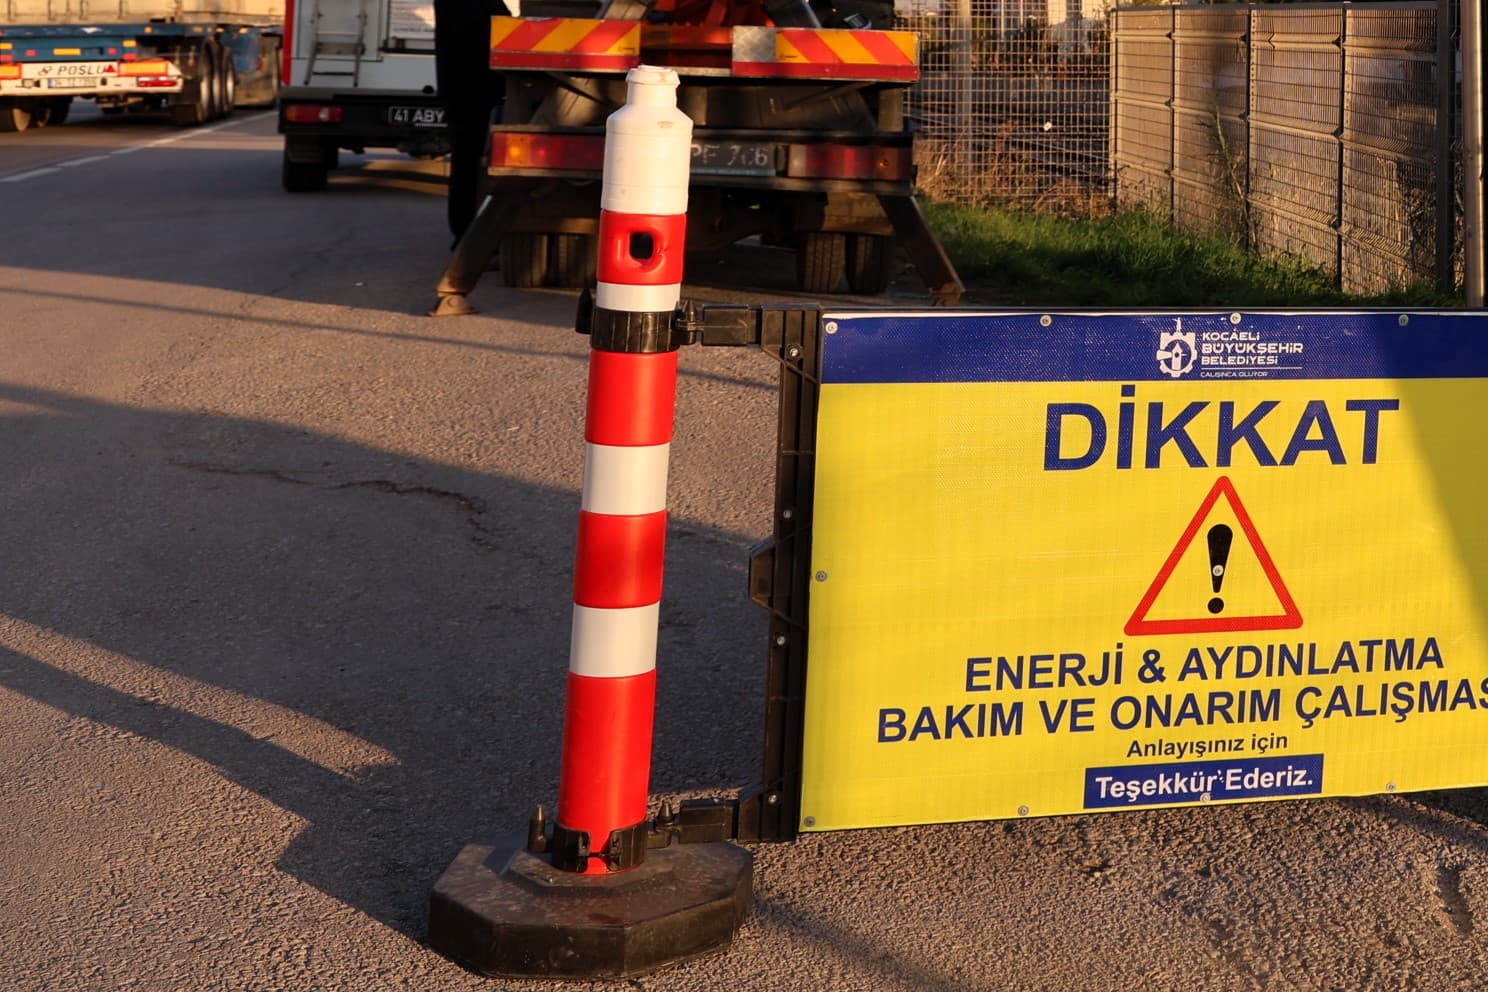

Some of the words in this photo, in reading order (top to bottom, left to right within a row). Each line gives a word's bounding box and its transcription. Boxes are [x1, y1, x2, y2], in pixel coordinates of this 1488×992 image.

[394, 109, 409, 121] 41
[1201, 342, 1304, 355] BÜYÜKŞEHİR
[1202, 331, 1260, 341] KOCAELİ
[1201, 355, 1278, 366] BELEDİYESİ
[1043, 384, 1400, 471] DİKKAT
[965, 643, 1124, 692] ENERJİ
[1137, 651, 1166, 685] &
[1179, 636, 1445, 682] AYDINLATMA
[876, 700, 1024, 743] BAKIM
[1038, 697, 1096, 734] VE
[1110, 688, 1282, 730] ONARIM
[1126, 738, 1244, 759] Anlayışınız
[1251, 733, 1288, 754] için
[1095, 771, 1218, 802] Teşekkür
[1225, 765, 1313, 790] Ederiz.
